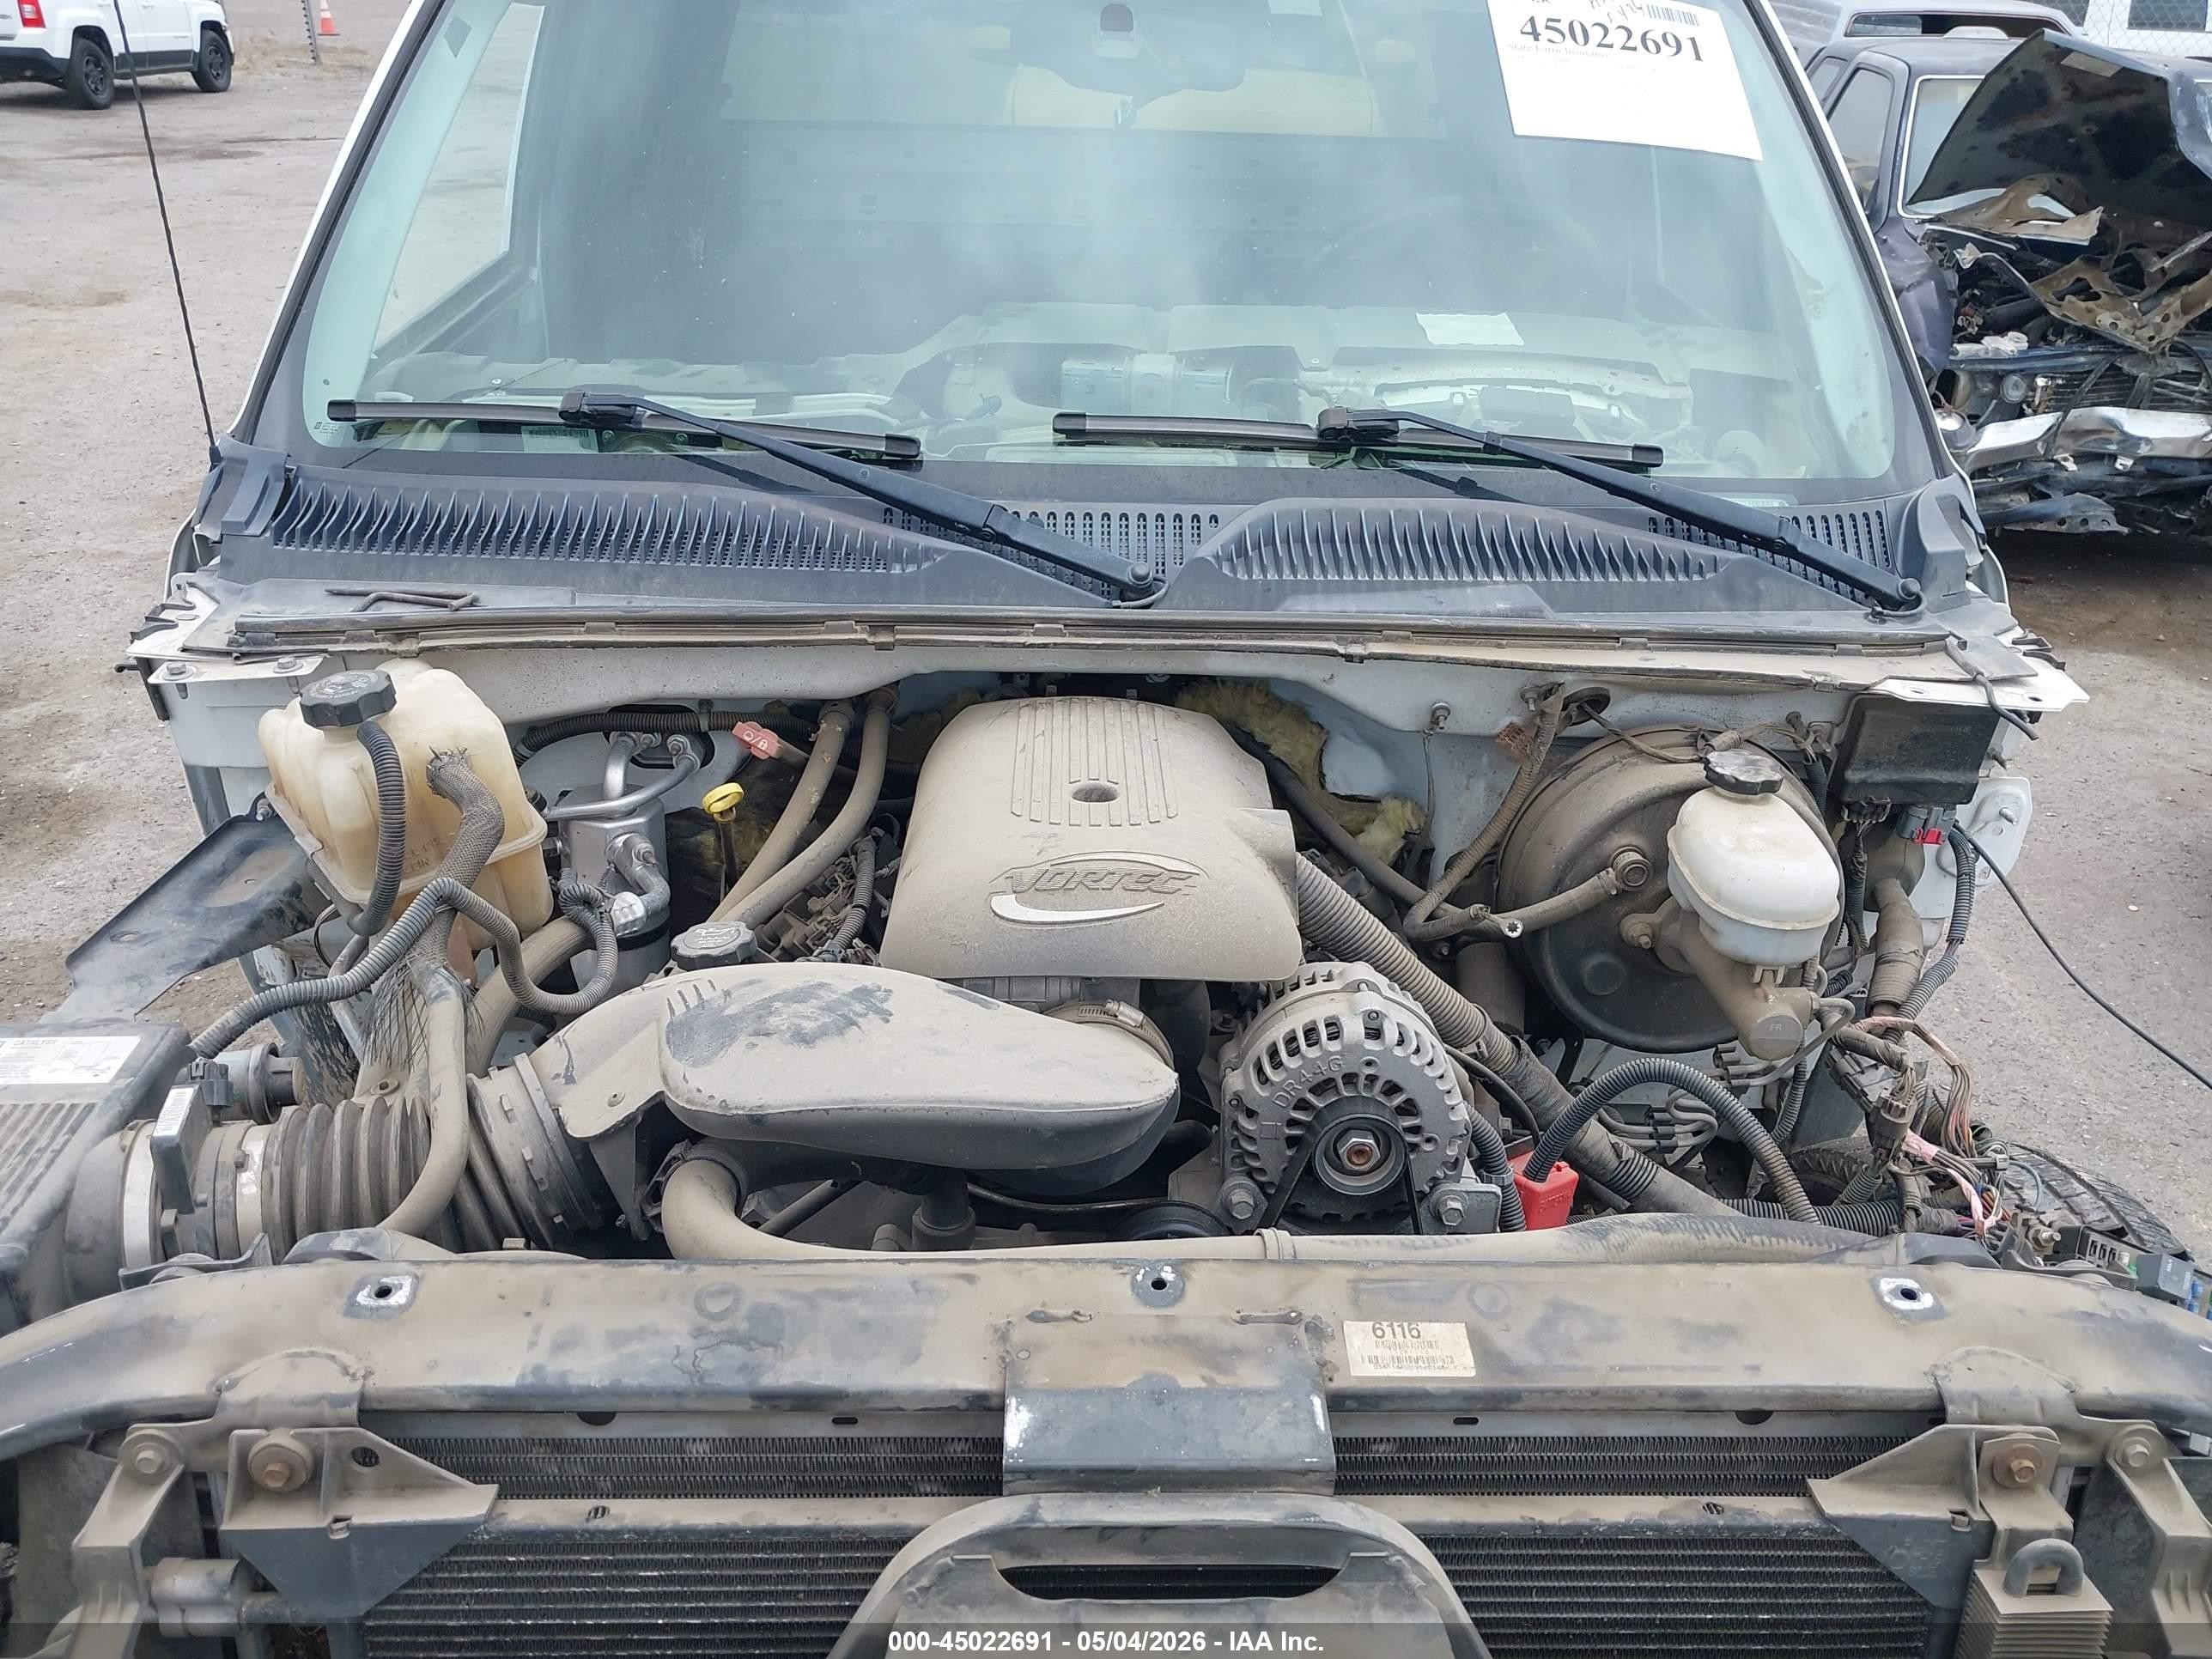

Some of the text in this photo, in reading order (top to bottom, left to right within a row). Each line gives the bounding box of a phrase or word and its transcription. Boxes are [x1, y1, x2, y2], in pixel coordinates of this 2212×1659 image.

[1519, 15, 1705, 62] 45022691
[1005, 866, 1194, 895] VORTEC
[1371, 1321, 1421, 1340] 6116
